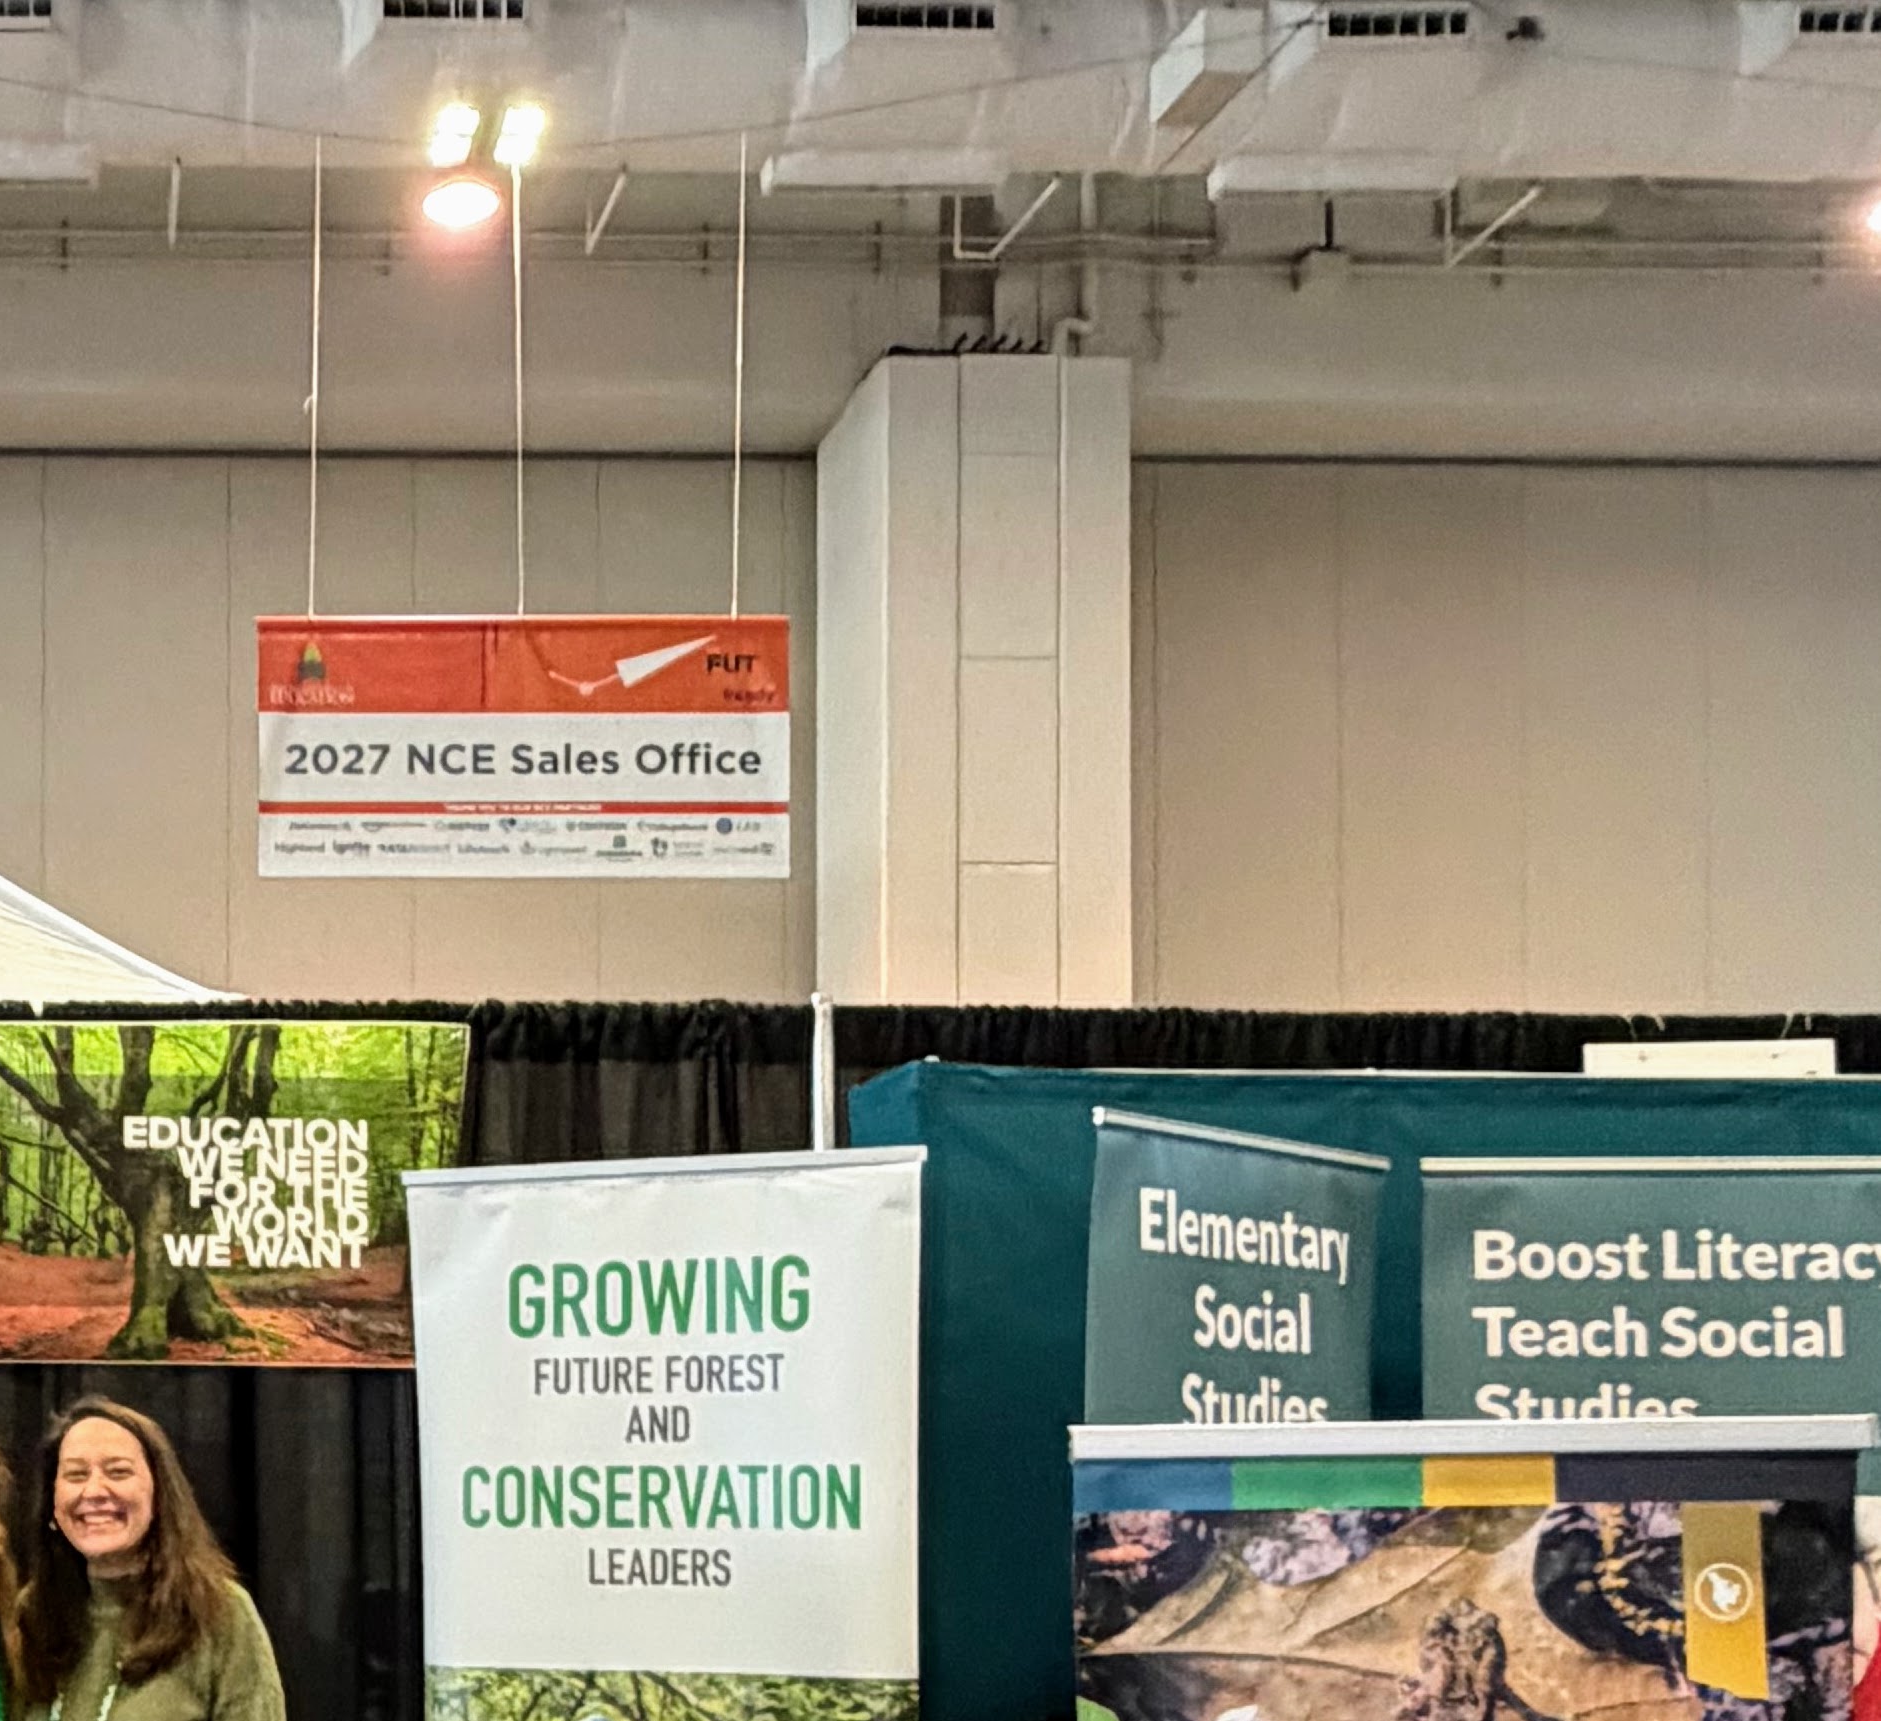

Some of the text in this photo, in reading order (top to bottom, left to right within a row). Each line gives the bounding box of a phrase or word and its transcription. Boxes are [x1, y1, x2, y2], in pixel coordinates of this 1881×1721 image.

[284, 741, 763, 776] 2027 NCE Sales Office
[122, 1115, 368, 1151] EDUCATION
[177, 1147, 368, 1181] WE NEED
[189, 1176, 368, 1210] FOR THE
[212, 1204, 368, 1242] WORLD
[1140, 1187, 1350, 1286] Elementary
[163, 1234, 367, 1269] WE WANT
[1473, 1228, 1881, 1289] Boost Literac
[508, 1255, 810, 1339] GROWING
[1193, 1284, 1312, 1355] Social
[1471, 1304, 1846, 1358] Teach Social
[534, 1353, 785, 1396] FUTURE FOREST
[625, 1405, 691, 1444] AND
[462, 1464, 862, 1530] CONSERVATION
[588, 1548, 732, 1587] LEADERS
